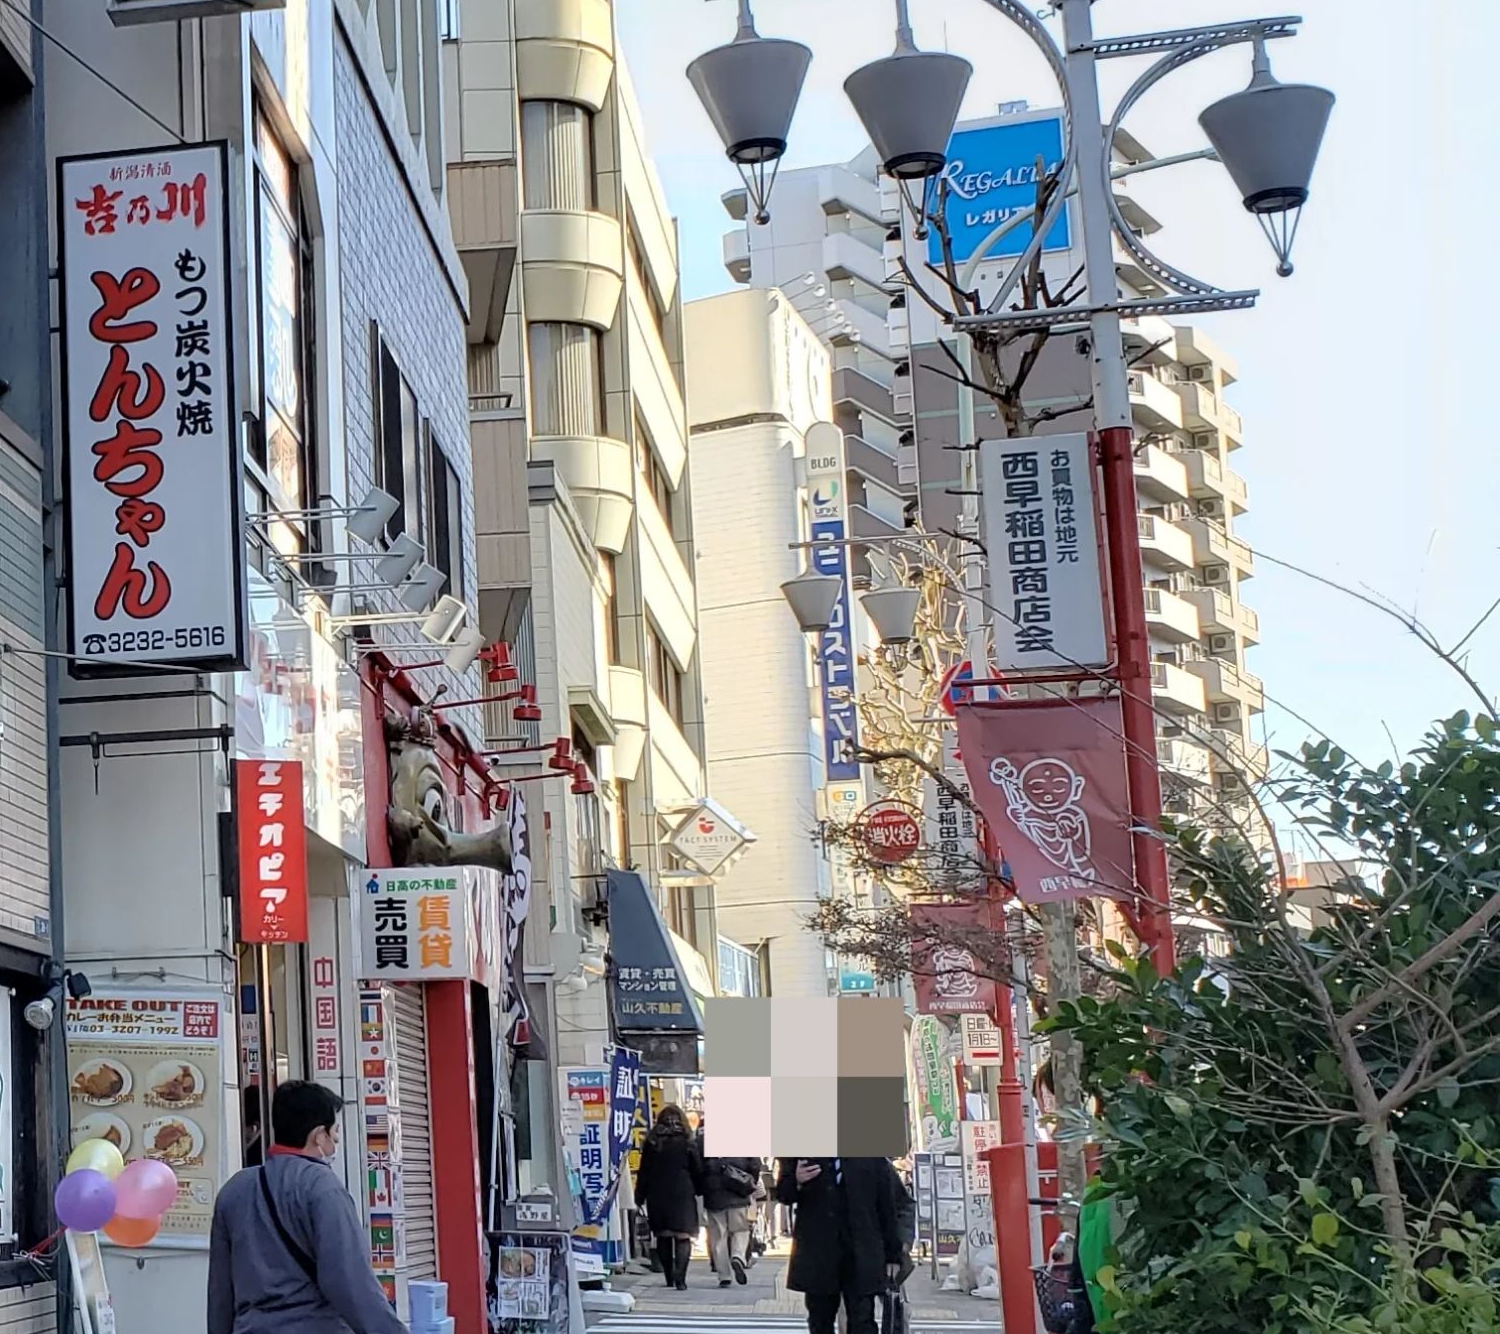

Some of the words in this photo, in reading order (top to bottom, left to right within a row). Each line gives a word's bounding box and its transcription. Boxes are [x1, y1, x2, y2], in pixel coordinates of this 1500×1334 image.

[76, 174, 207, 237] 吉乃川
[174, 249, 214, 437] もつ炭火焼
[89, 266, 172, 620] とんちゃん
[811, 457, 837, 470] BLDG
[1050, 450, 1079, 564] お買物は地元
[1001, 451, 1053, 653] 西早稲田商店会
[109, 625, 225, 653] 3232-5616
[257, 763, 288, 913] エチオピア
[703, 835, 737, 843] SYSTEM
[868, 824, 917, 846] 消火栓
[386, 878, 458, 892] 日高の不動産
[374, 897, 409, 969] 売買
[417, 895, 453, 968] 賃貸
[132, 999, 182, 1012] OUT
[314, 957, 338, 1071] 中国語
[973, 1126, 989, 1188] 駐停禁止
